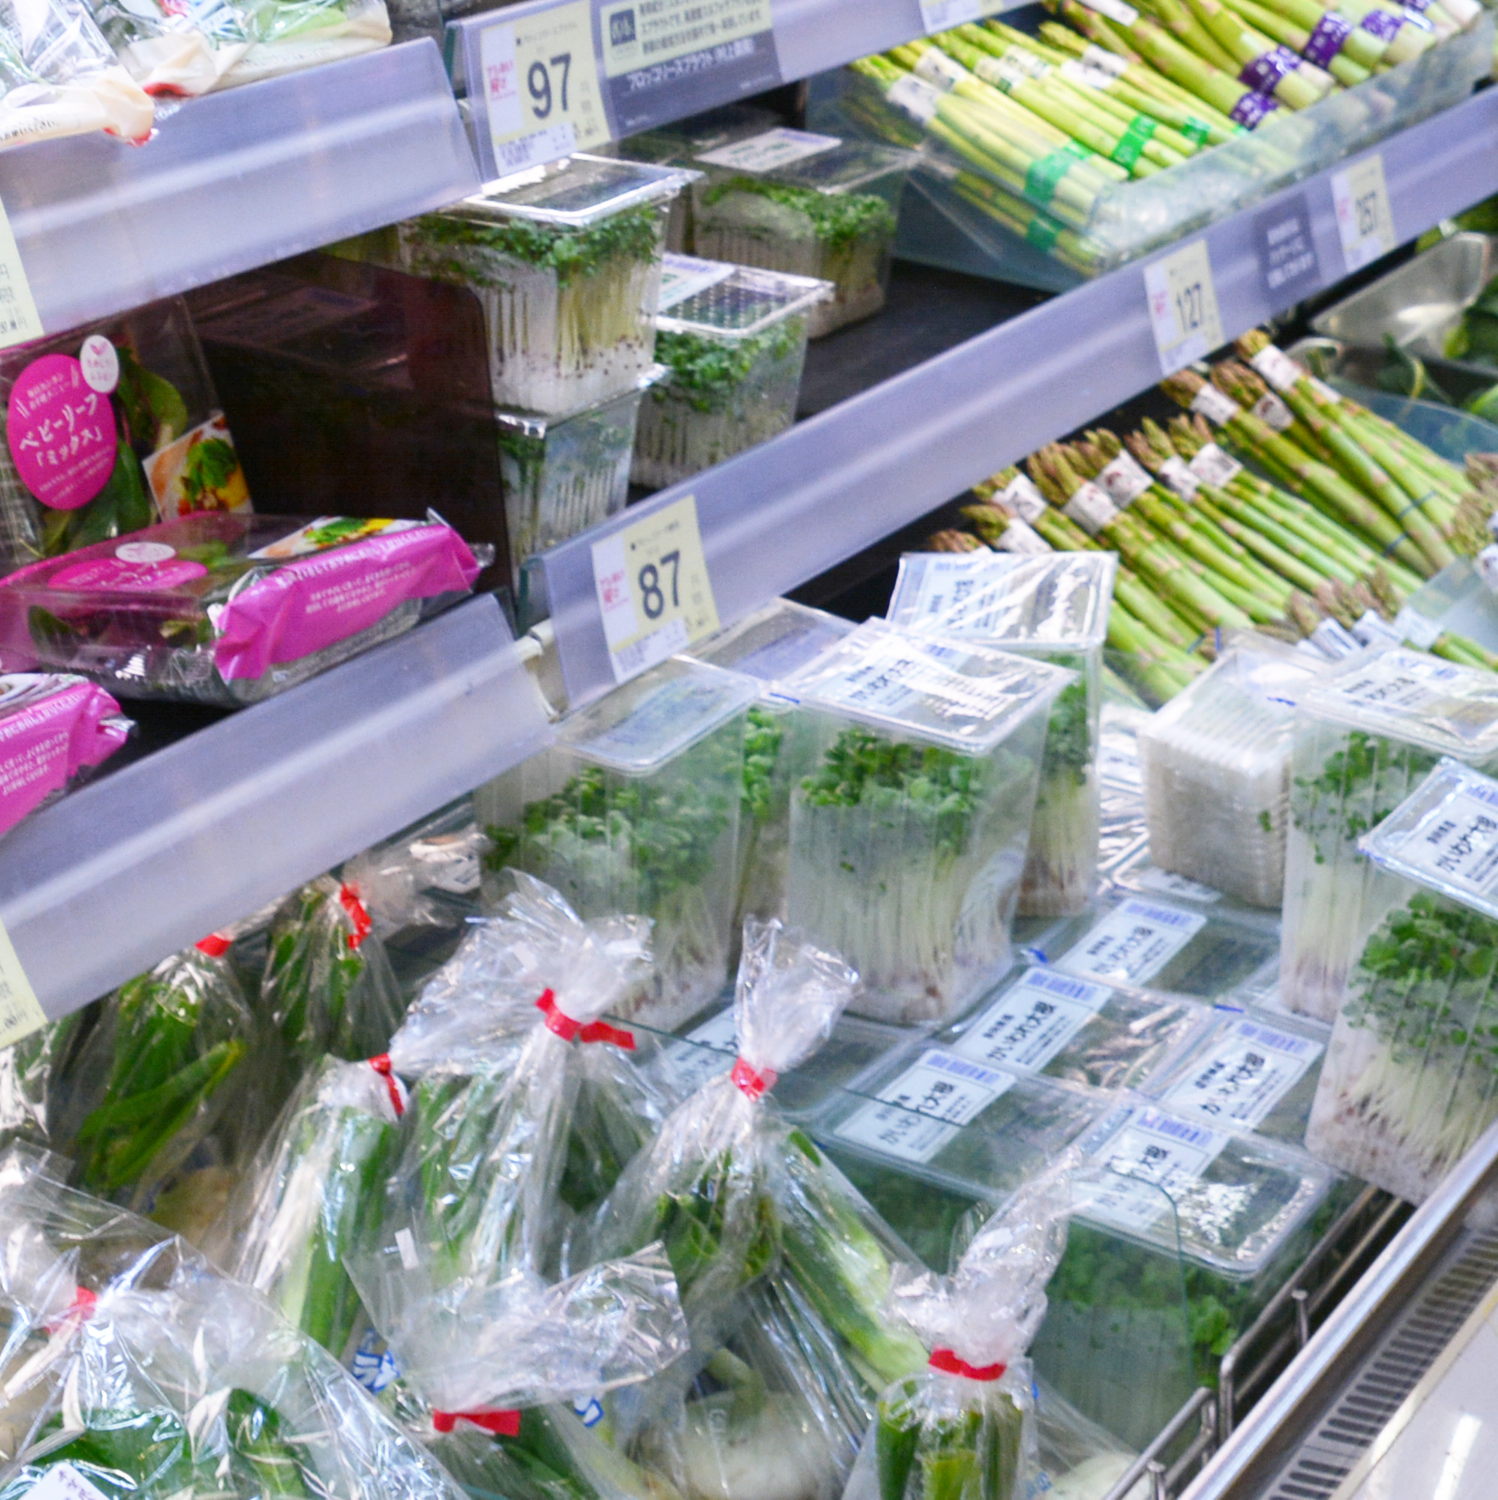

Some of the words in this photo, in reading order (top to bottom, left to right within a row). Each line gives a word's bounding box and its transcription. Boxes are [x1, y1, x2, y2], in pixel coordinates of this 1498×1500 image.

[526, 52, 572, 120] 97
[1173, 275, 1207, 335] 127
[19, 392, 99, 451] ベビーリーフ
[638, 549, 681, 620] 87
[986, 999, 1058, 1063] かいわれ大根
